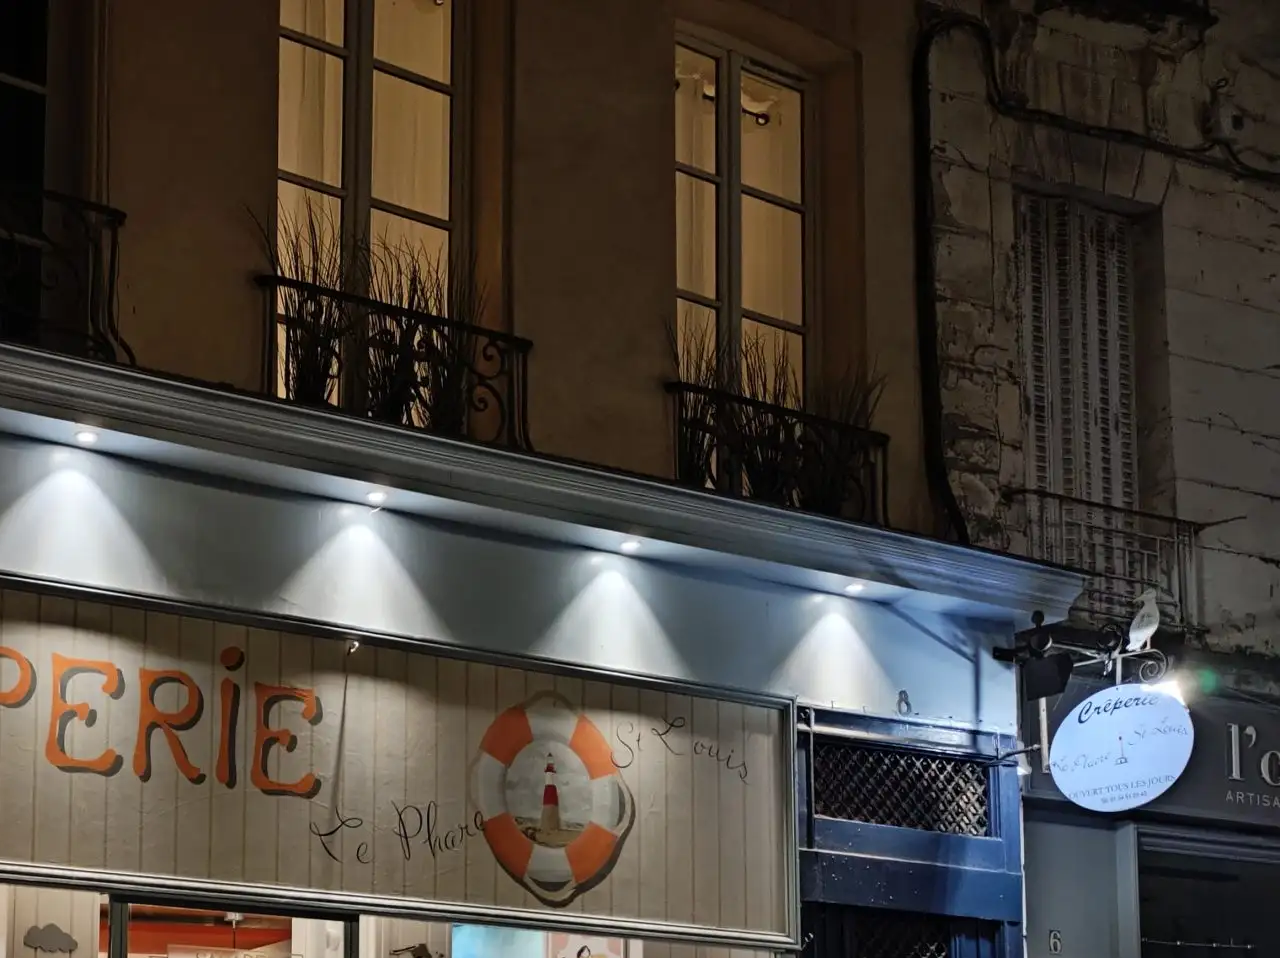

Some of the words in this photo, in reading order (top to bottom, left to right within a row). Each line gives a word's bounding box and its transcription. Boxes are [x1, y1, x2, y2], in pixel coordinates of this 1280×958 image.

[897, 689, 912, 716] 8
[1077, 692, 1158, 724] Crêperie
[651, 716, 750, 785] Louis
[391, 800, 486, 861] Phare
[1050, 930, 1061, 954] 6
